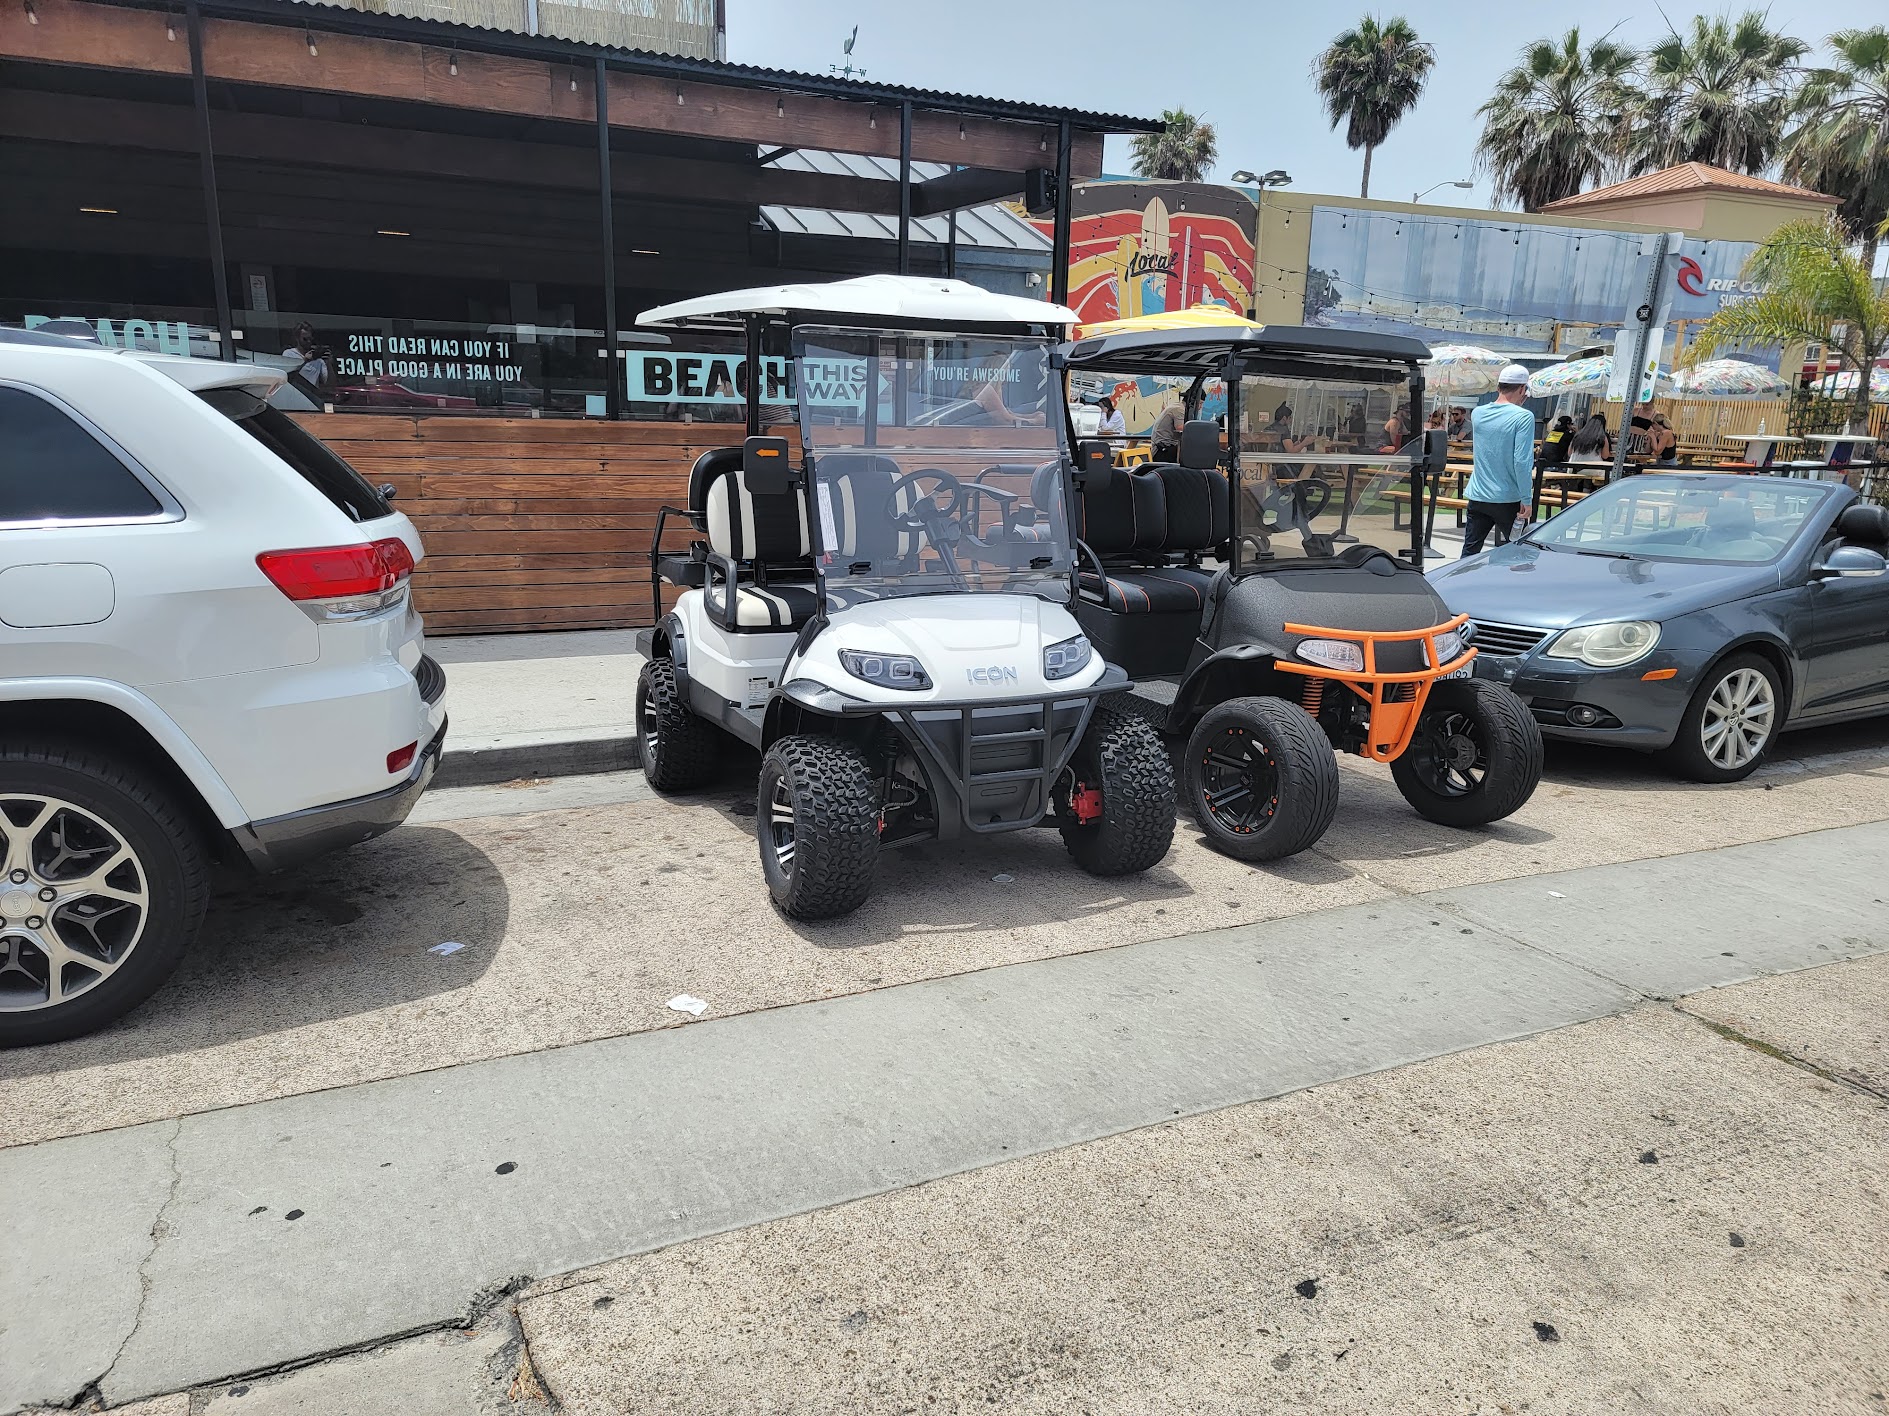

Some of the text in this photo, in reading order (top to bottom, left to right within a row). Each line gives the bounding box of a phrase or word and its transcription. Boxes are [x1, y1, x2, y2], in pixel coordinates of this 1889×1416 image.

[1706, 278, 1738, 292] RIP
[806, 363, 868, 382] THIS
[933, 366, 1021, 383] YOU'RE AWESOME
[805, 382, 868, 400] WAY
[966, 665, 1018, 683] ICON
